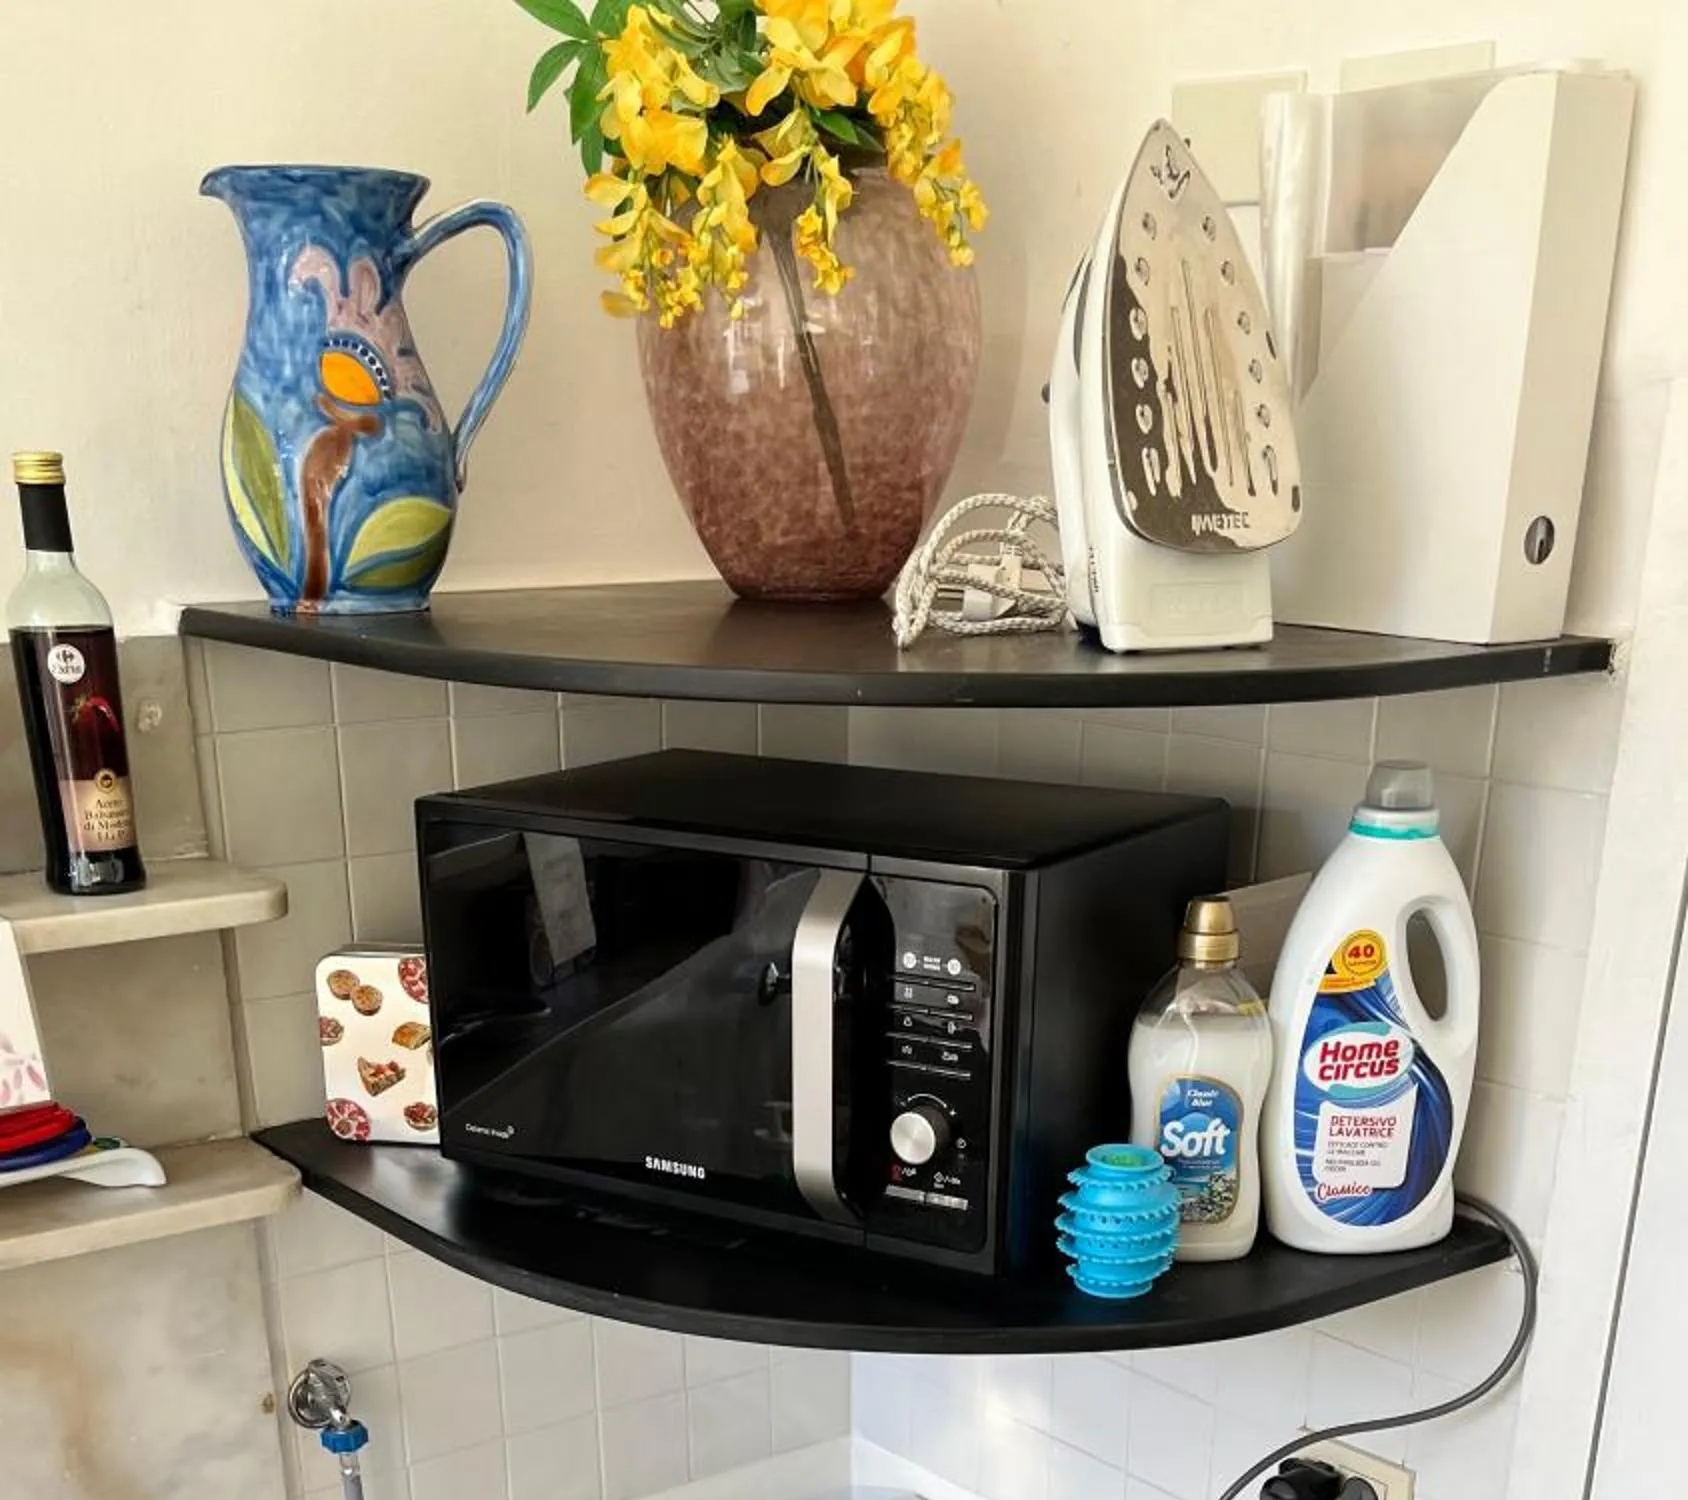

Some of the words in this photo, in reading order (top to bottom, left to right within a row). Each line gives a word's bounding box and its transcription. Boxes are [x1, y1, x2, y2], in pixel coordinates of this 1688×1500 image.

[1191, 511, 1250, 536] IMETEC
[1347, 943, 1375, 959] 40
[1319, 1039, 1399, 1063] Home
[1317, 1058, 1400, 1082] circus
[1329, 1127, 1395, 1138] LAVATRICE
[1330, 1115, 1398, 1127] DETERSIVO
[1160, 1118, 1231, 1158] Soft
[645, 1155, 706, 1180] SAMSUNG
